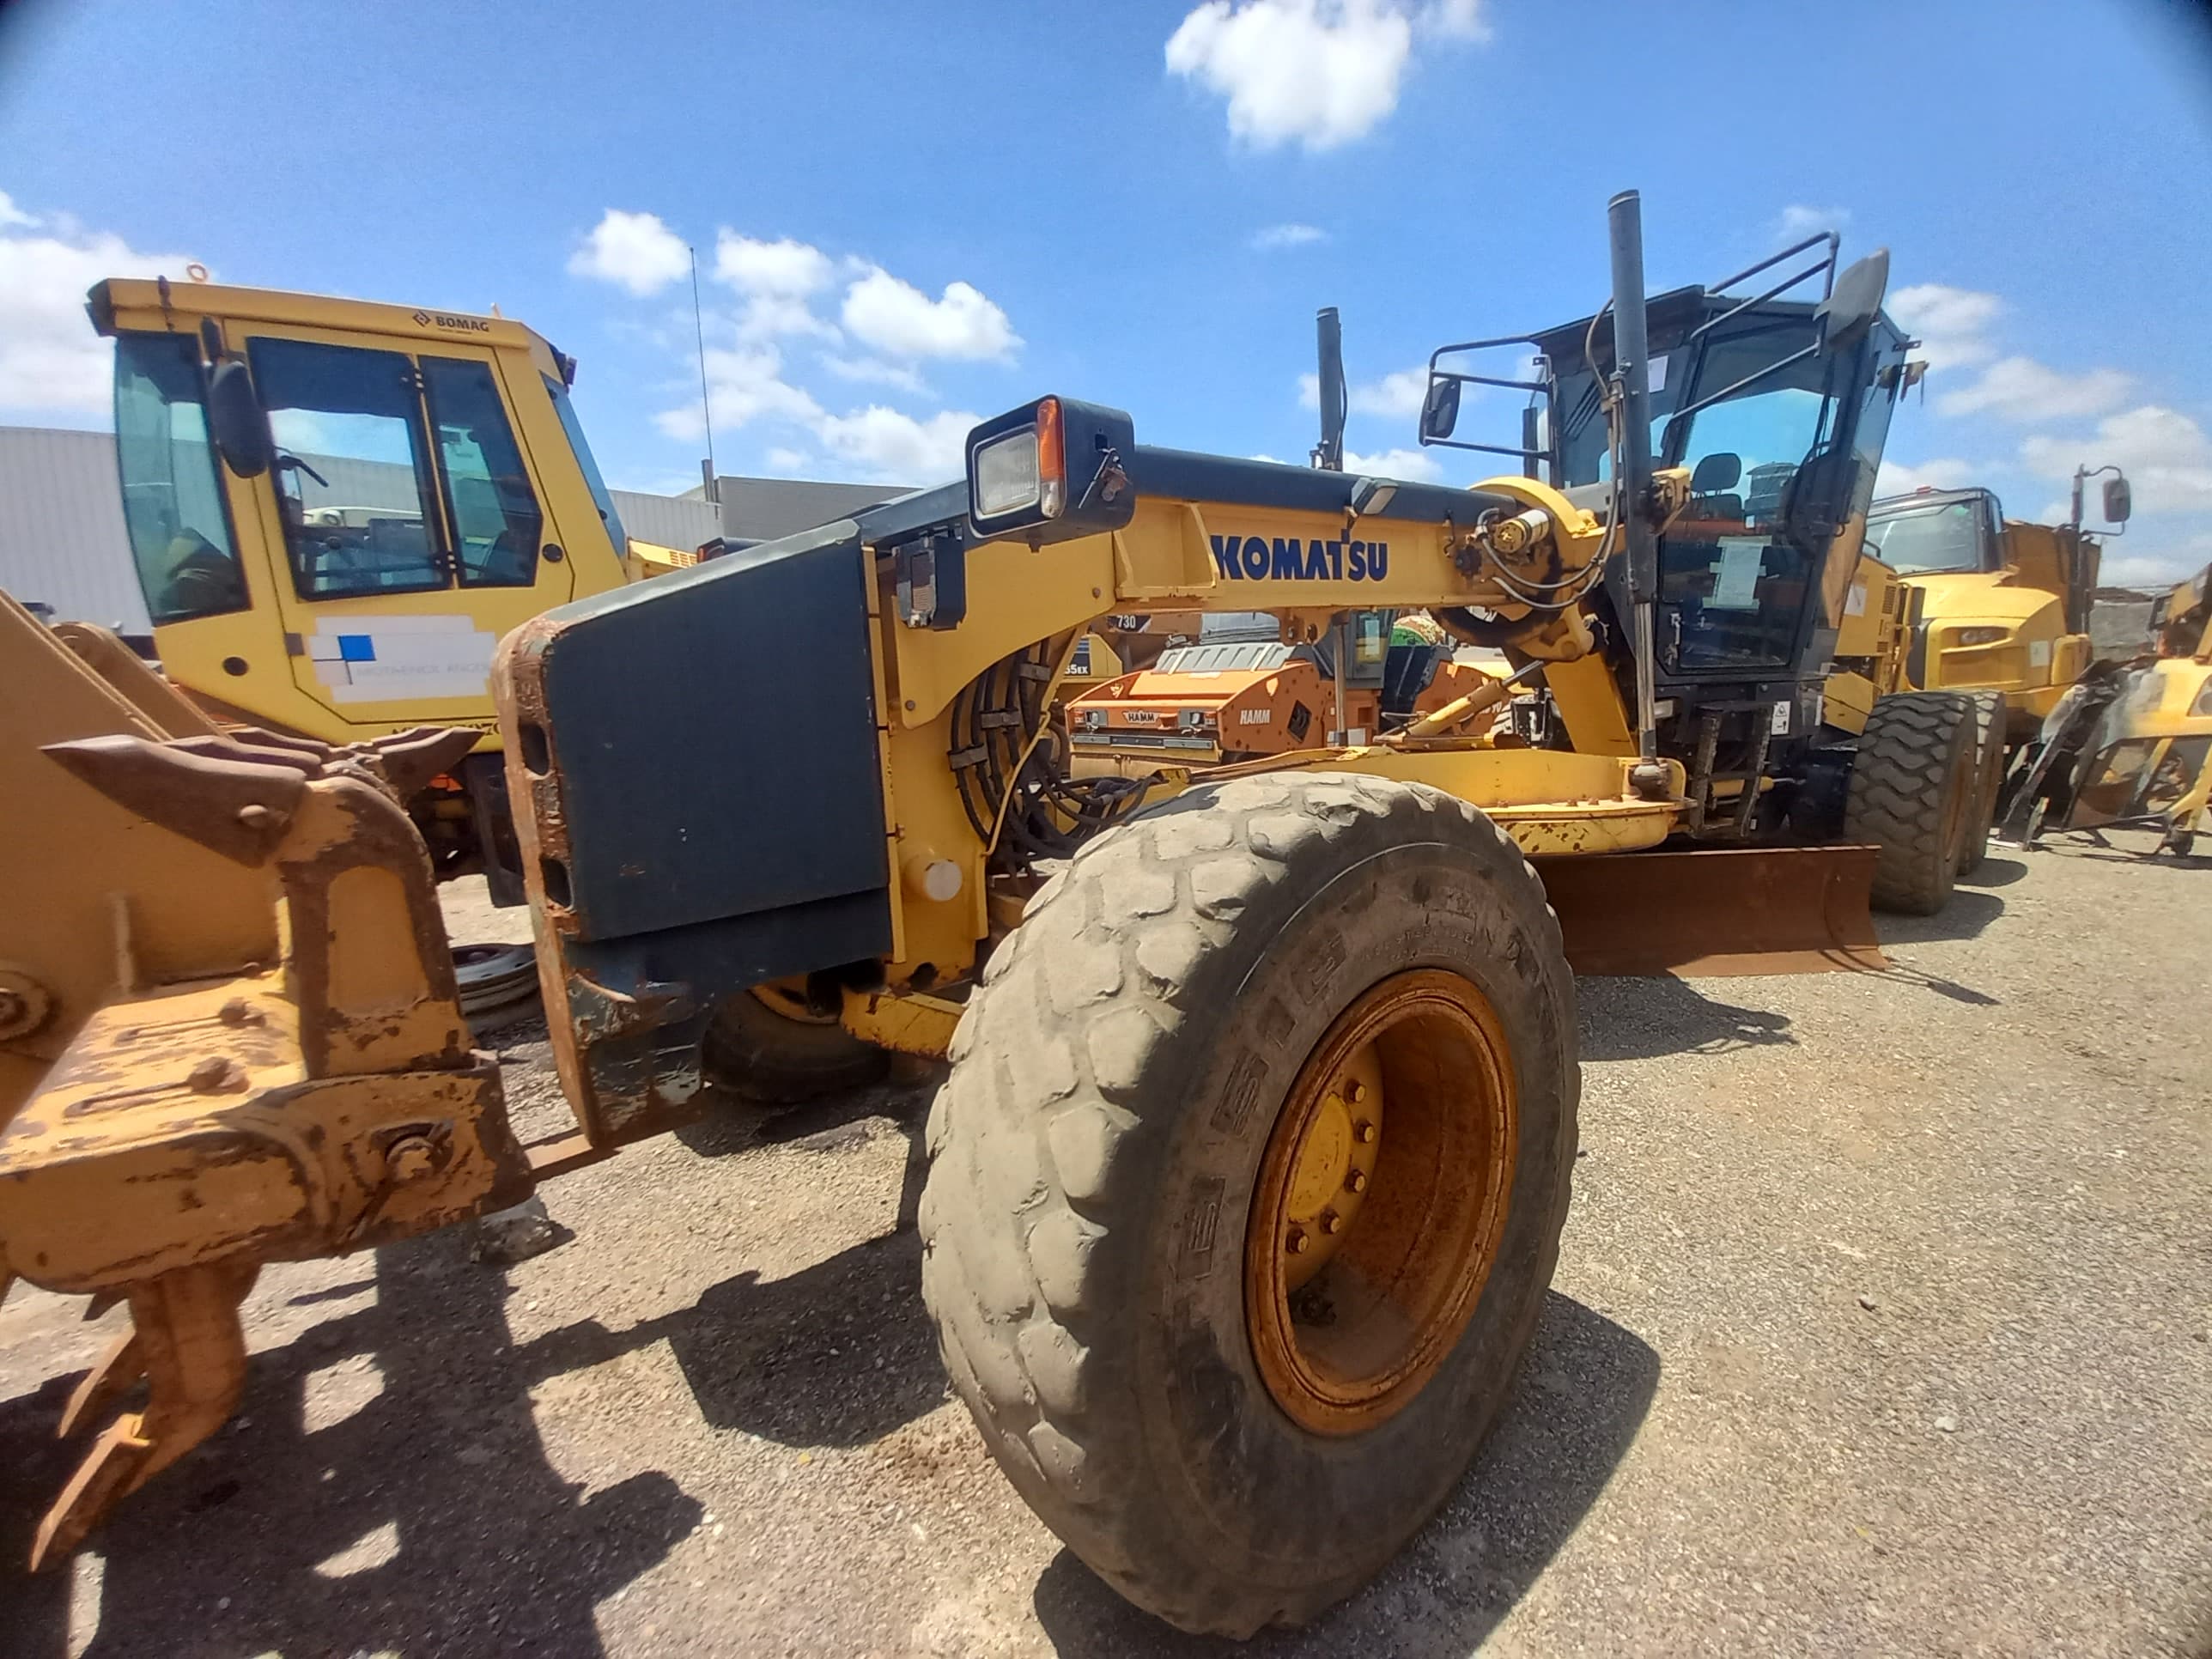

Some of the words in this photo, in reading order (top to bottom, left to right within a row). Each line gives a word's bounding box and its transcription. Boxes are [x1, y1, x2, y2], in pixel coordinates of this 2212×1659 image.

[435, 315, 489, 332] BOMAG
[1210, 528, 1388, 581] KOMATSU
[1116, 615, 1136, 629] 730
[1127, 712, 1156, 723] HAMM
[1239, 708, 1271, 725] HAMM
